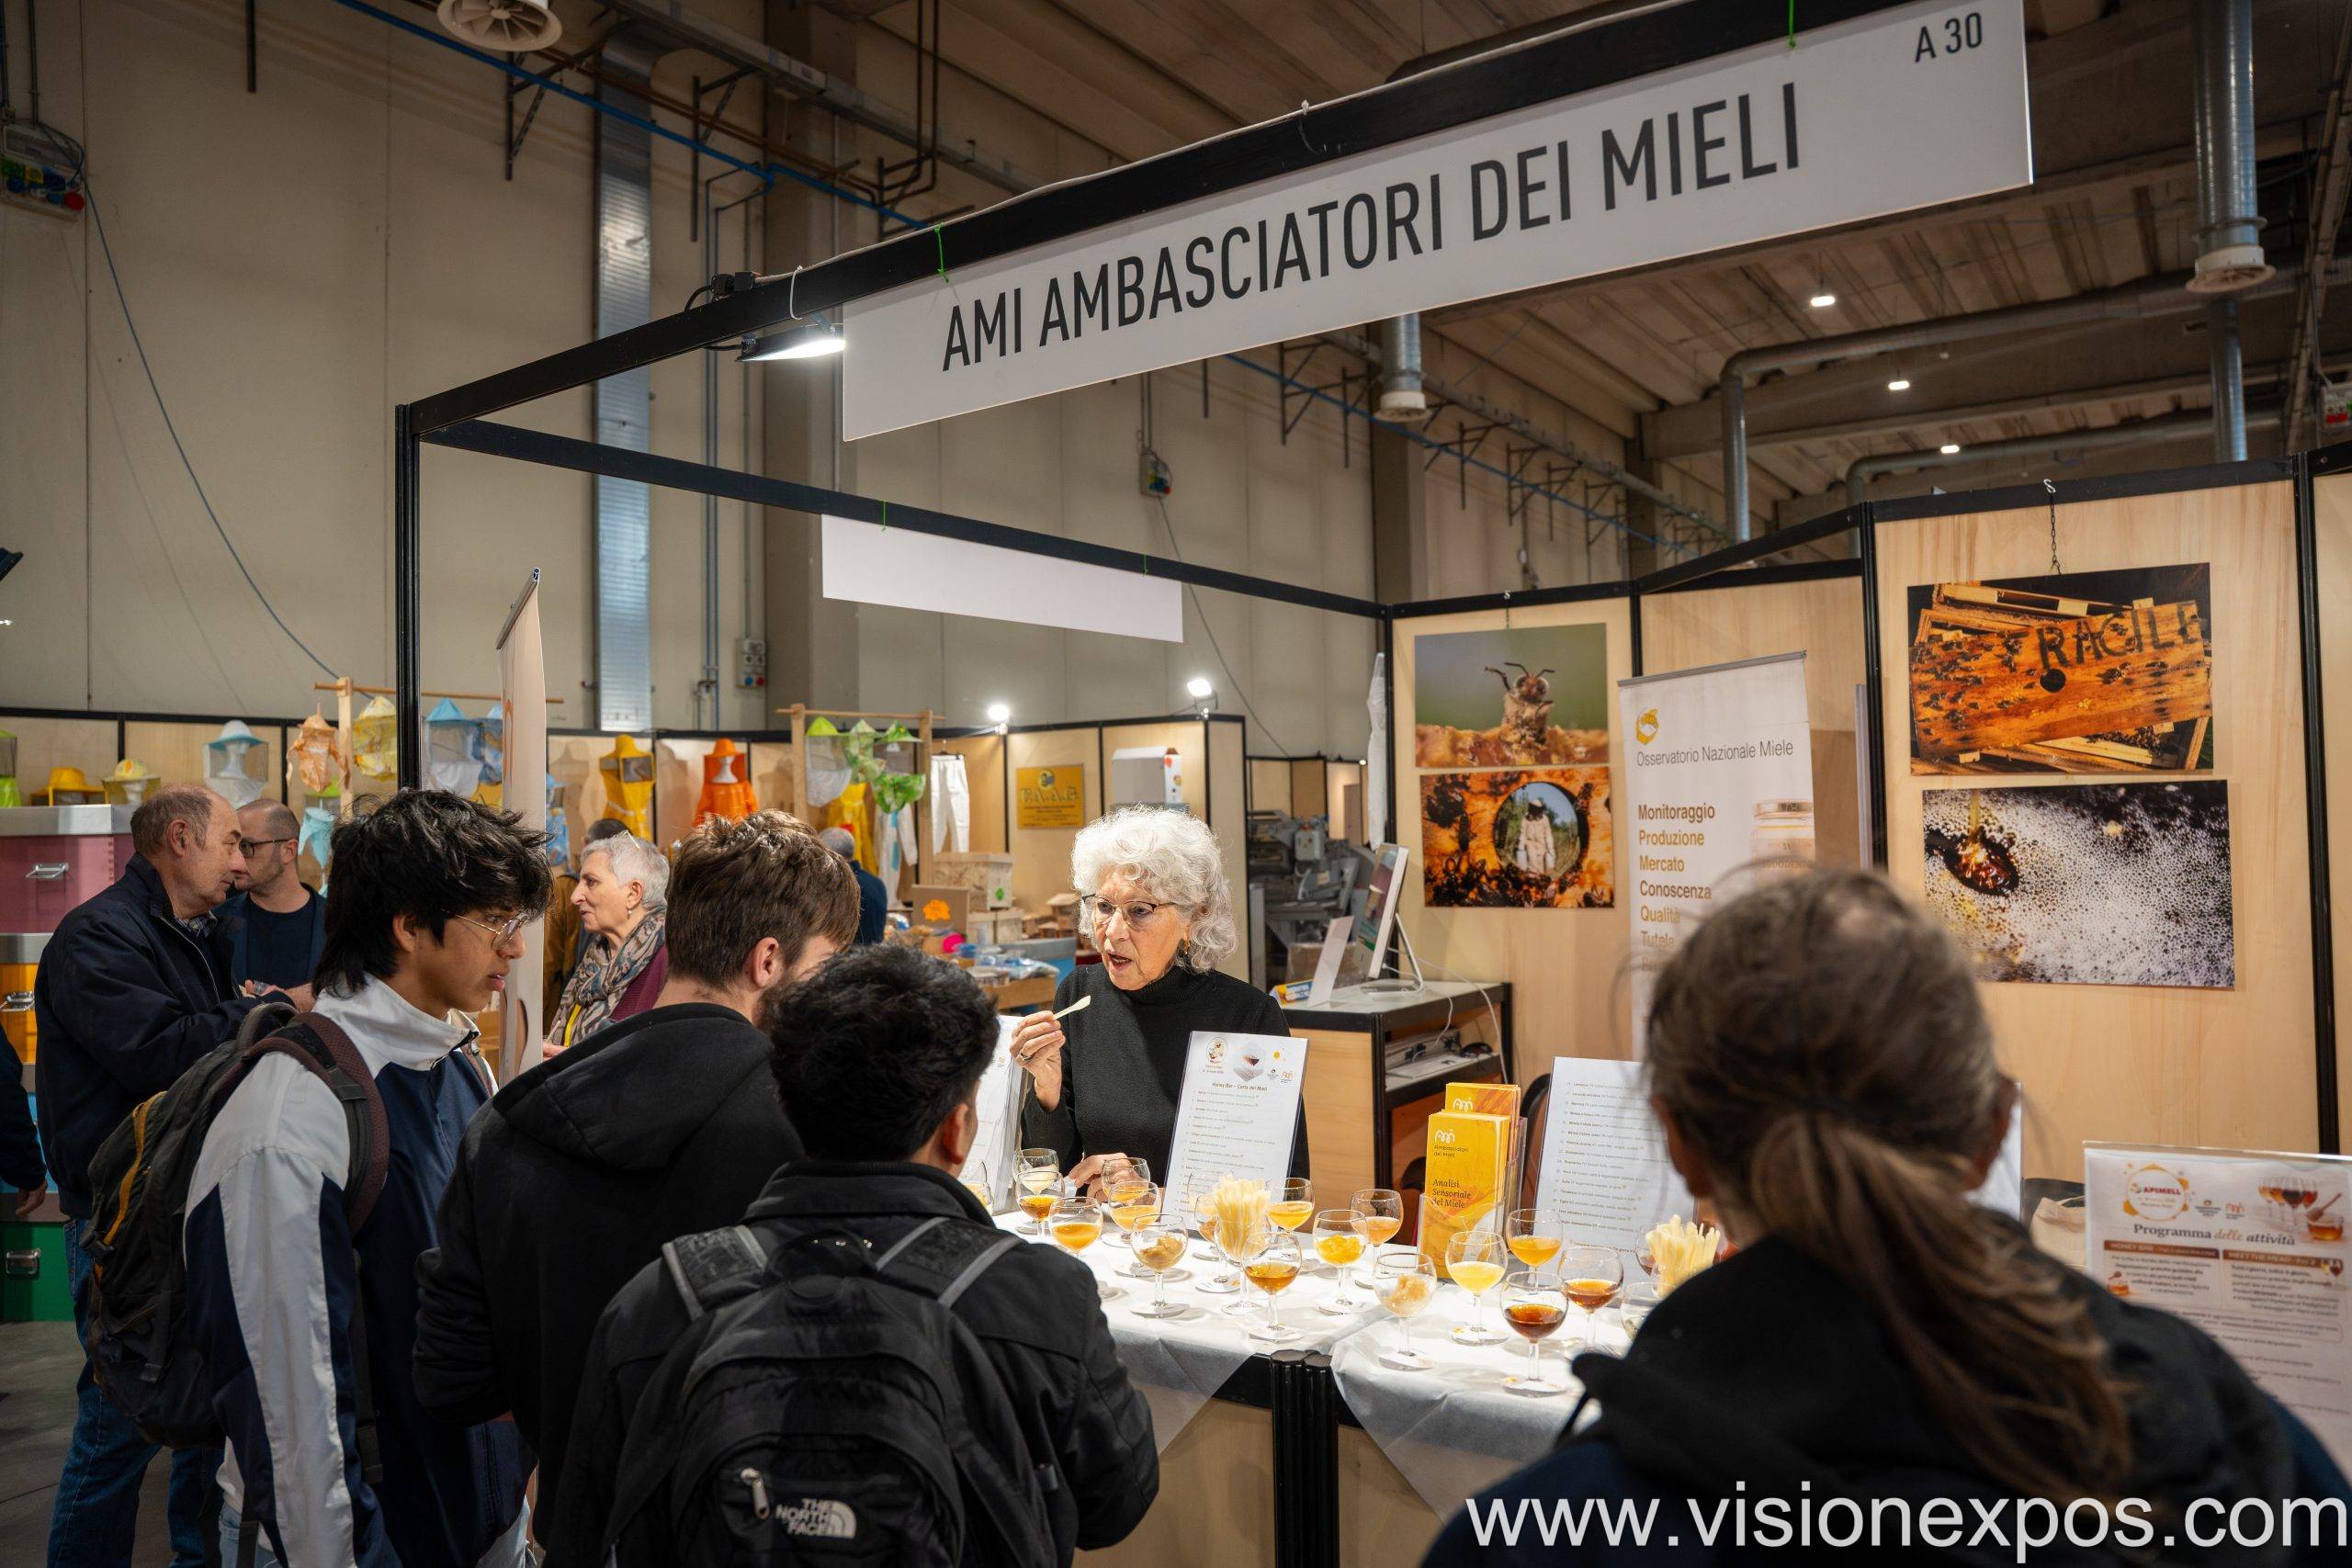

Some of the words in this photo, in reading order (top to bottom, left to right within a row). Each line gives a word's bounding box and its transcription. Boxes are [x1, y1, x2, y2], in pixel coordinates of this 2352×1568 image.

[1914, 26, 1938, 63] A
[1944, 11, 1984, 54] 30
[942, 287, 1023, 373] AMI
[1038, 174, 1443, 348] AMBASCIATORI
[1470, 140, 1571, 242] DEI
[1601, 82, 1800, 211] MIELI
[1636, 748, 1699, 767] Osservatorio
[1702, 744, 1756, 761] Nazionale
[1759, 739, 1793, 757] Miele
[1638, 802, 1715, 824] Monitoraggio
[1639, 829, 1705, 846] Produzione
[1639, 855, 1685, 872] Mercato
[1639, 880, 1712, 900] Conoscenza
[1640, 931, 1675, 949] Tutela
[1432, 1179, 1460, 1189] Analisi
[1432, 1188, 1472, 1200] Sensoriale
[1430, 1198, 1443, 1206] del
[1444, 1199, 1465, 1209] Miele
[2132, 1224, 2212, 1239] Programma
[2213, 1229, 2244, 1241] delle
[2245, 1232, 2296, 1246] attività
[801, 1497, 831, 1513] THE
[775, 1504, 831, 1525] NORTH
[786, 1521, 832, 1538] FACE
